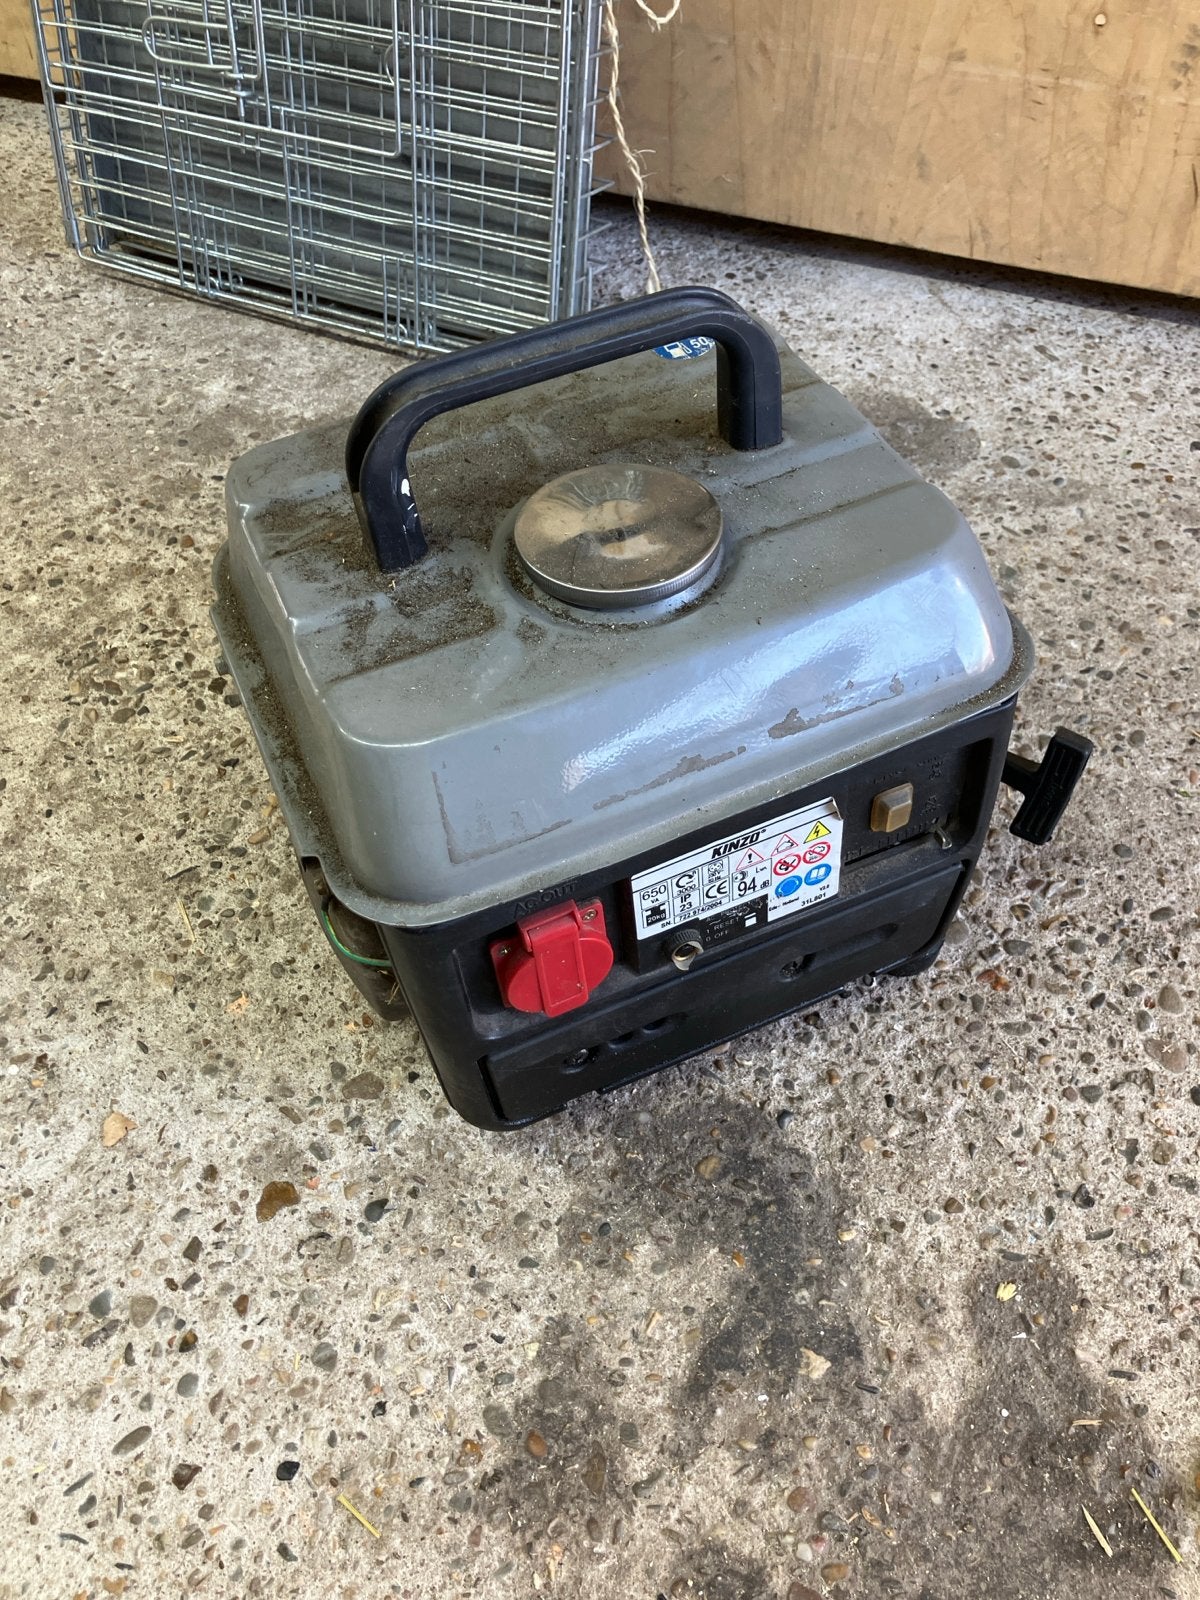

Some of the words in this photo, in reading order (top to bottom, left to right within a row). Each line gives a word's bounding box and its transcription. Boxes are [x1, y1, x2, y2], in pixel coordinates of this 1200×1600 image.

[711, 831, 761, 859] KINZO
[642, 884, 667, 900] 650
[676, 884, 697, 896] 3000
[705, 880, 728, 898] CE
[737, 876, 757, 897] 94
[760, 879, 770, 889] dB
[680, 893, 692, 903] IP
[679, 902, 693, 912] 23
[647, 913, 666, 923] 20kg
[713, 917, 739, 931] RESET
[714, 930, 729, 939] OFF
